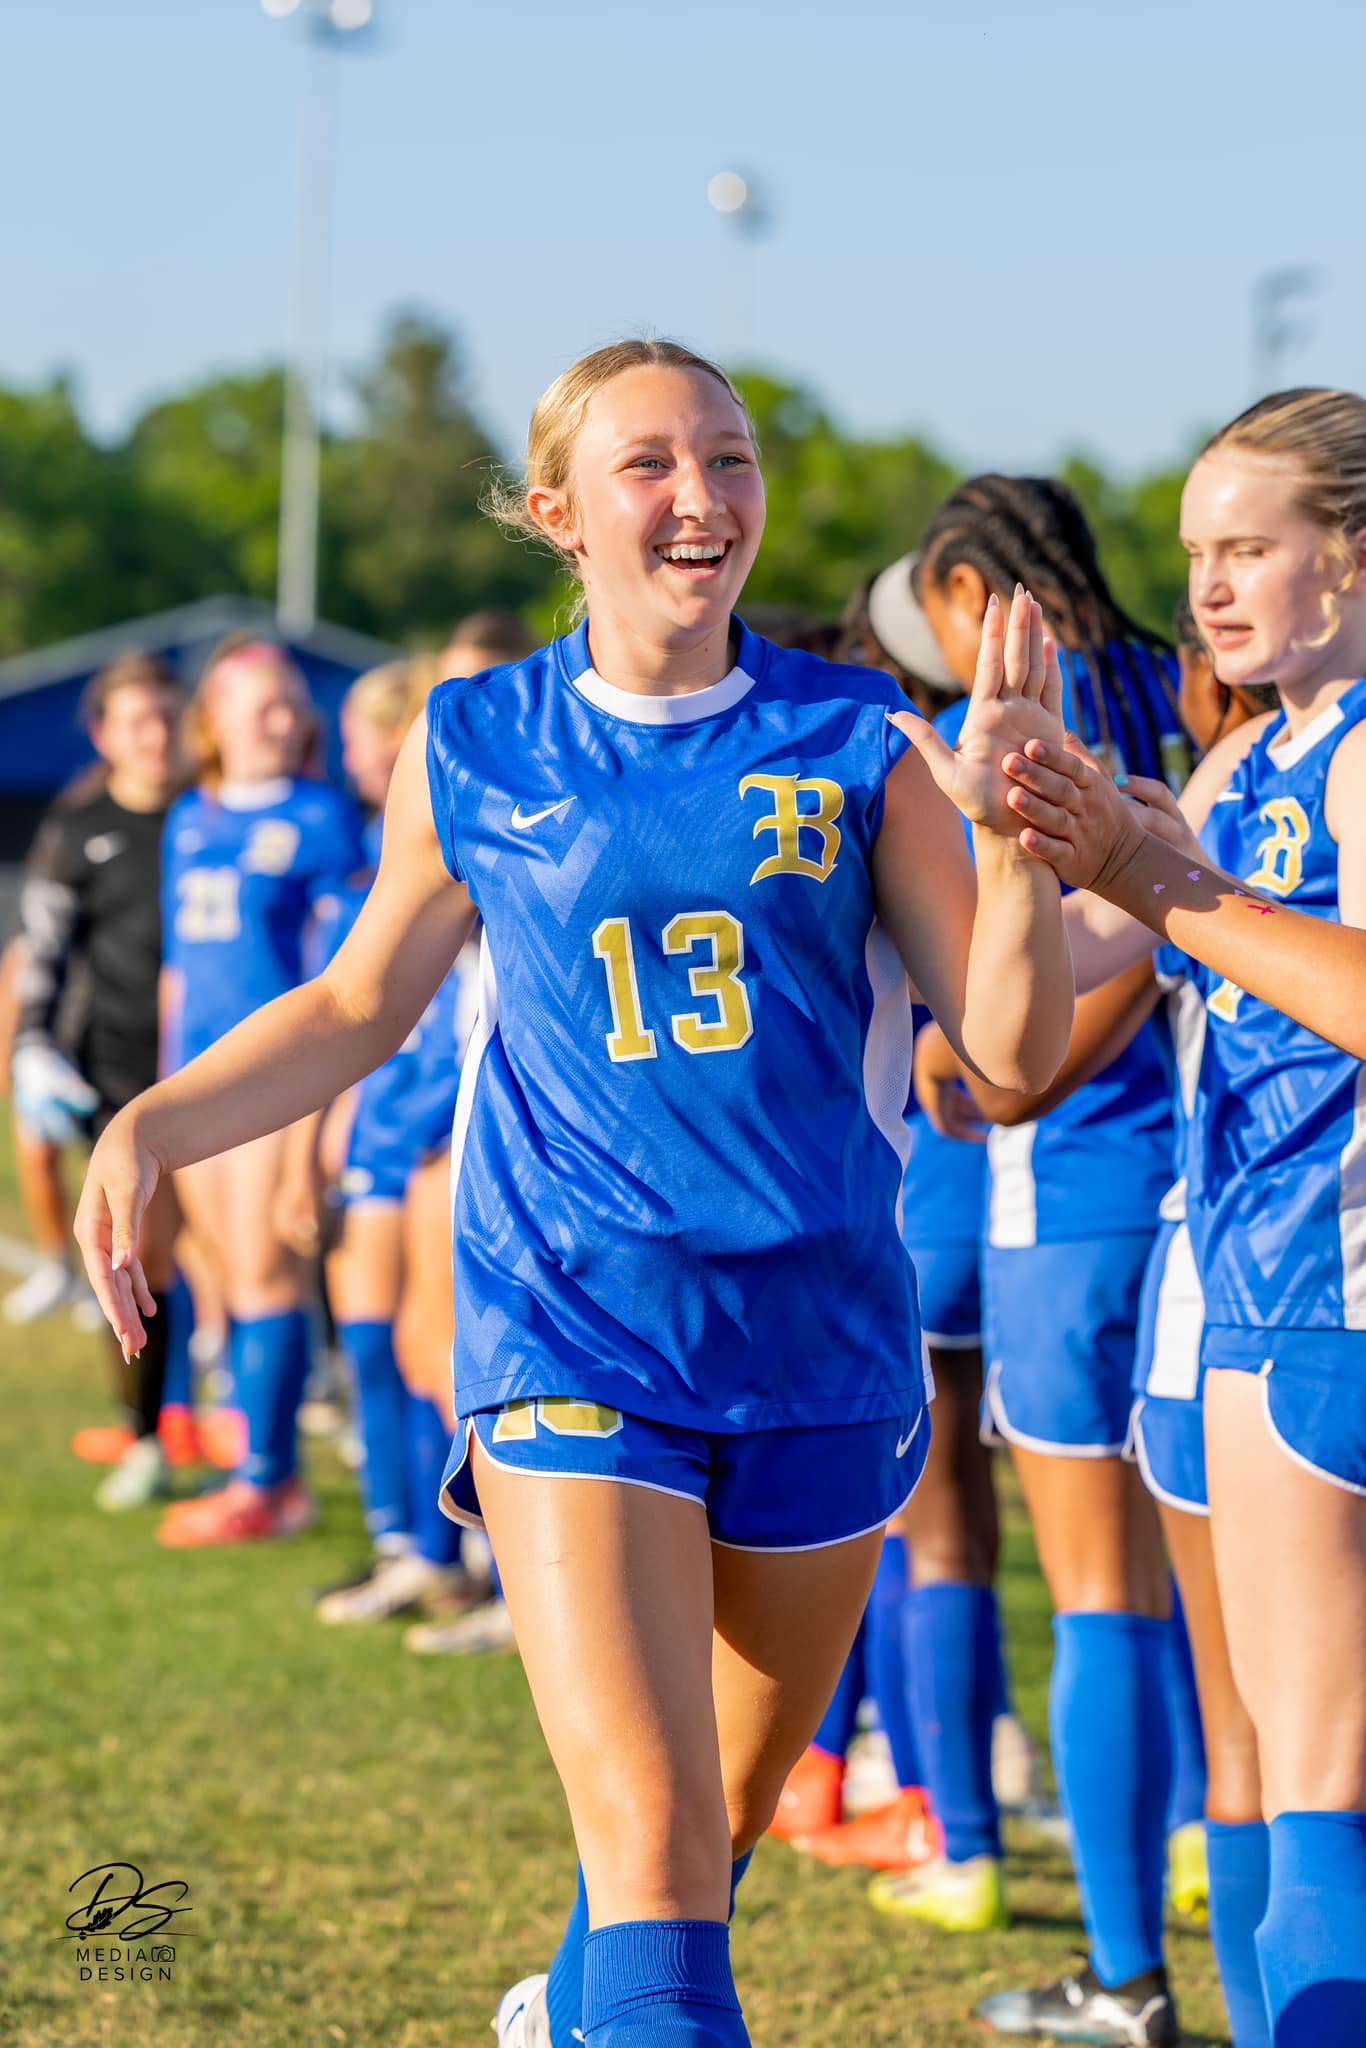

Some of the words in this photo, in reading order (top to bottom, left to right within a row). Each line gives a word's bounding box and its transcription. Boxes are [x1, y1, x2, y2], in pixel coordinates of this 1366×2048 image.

[739, 773, 844, 886] B
[1243, 796, 1310, 897] B
[592, 911, 753, 1062] 13
